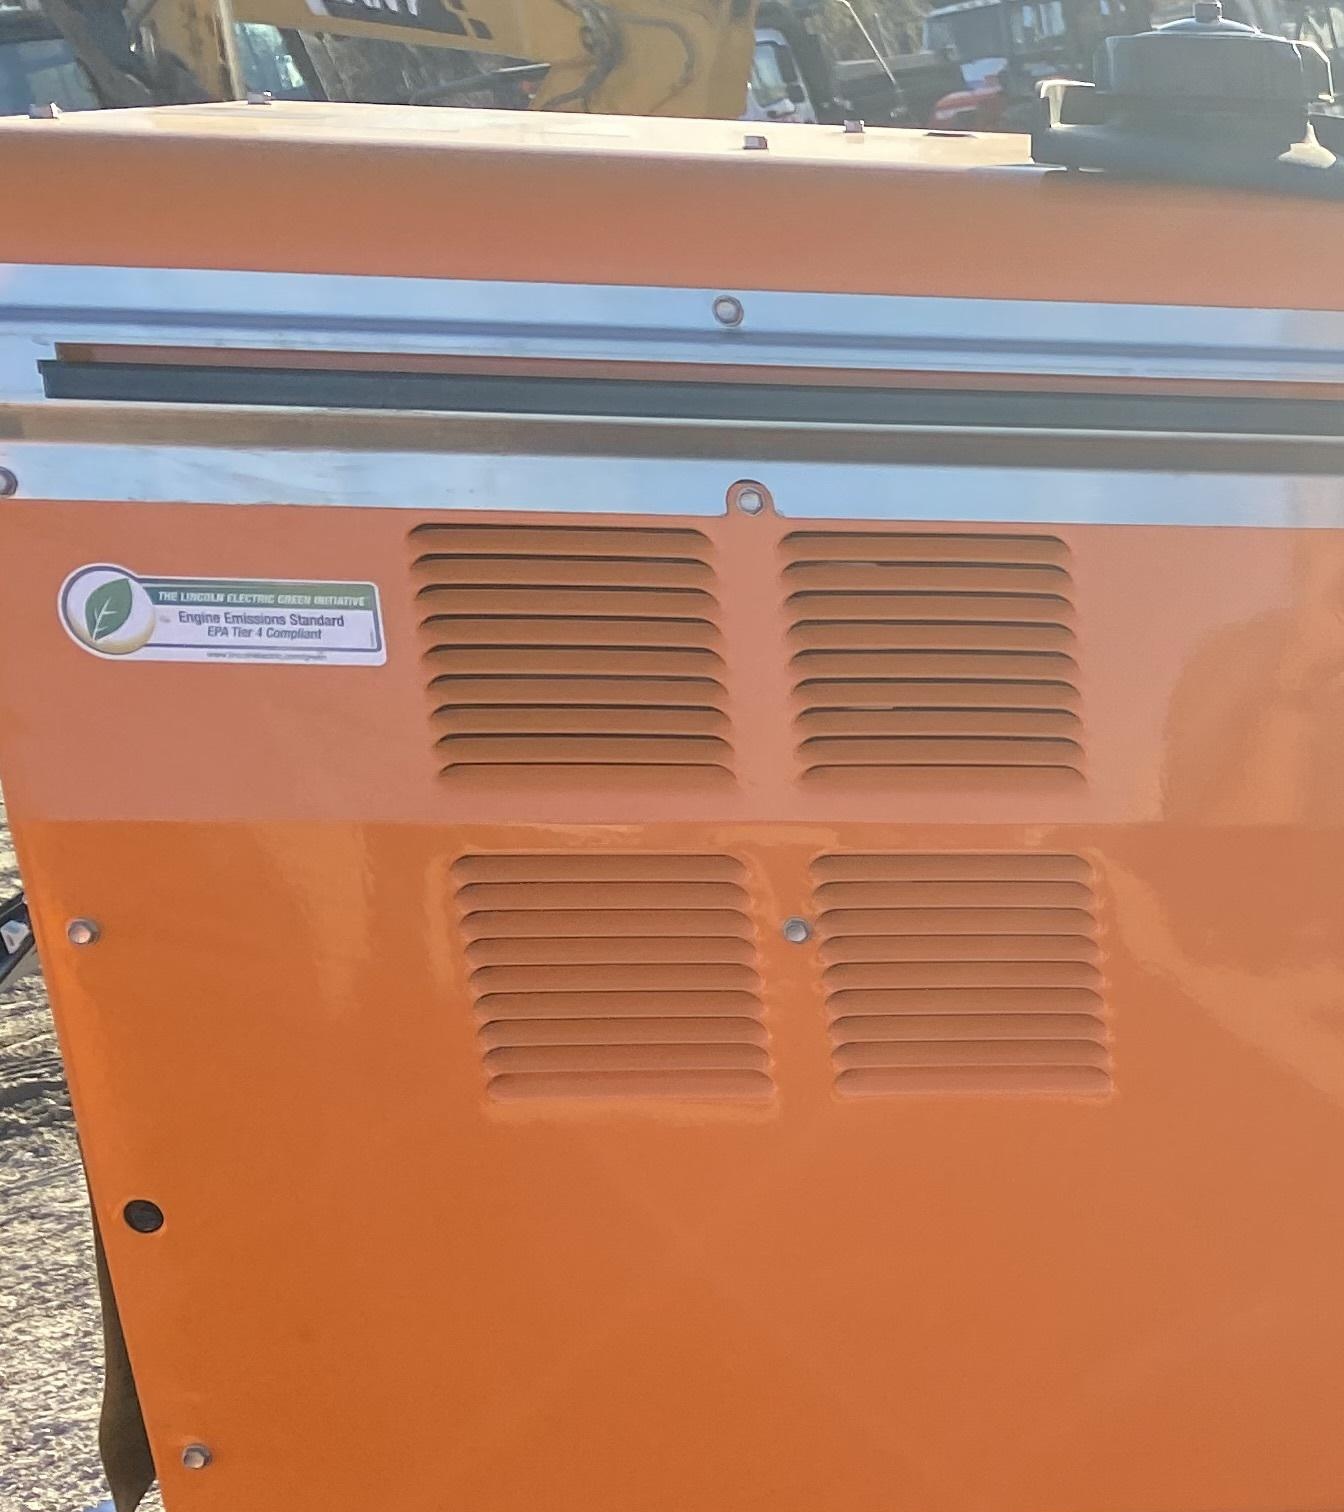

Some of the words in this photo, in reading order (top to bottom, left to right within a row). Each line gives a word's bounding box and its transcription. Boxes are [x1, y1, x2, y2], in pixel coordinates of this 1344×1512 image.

[158, 591, 177, 601] THE
[180, 592, 225, 602] LINCOLN
[227, 593, 275, 604] ELECTRIC
[278, 594, 312, 605] GREEN
[314, 596, 365, 607] INITIATIVE
[178, 610, 221, 626] Engine
[224, 612, 287, 626] Emissions
[289, 613, 345, 627] Standard
[207, 625, 229, 638] EPA
[231, 626, 253, 638] Tier
[255, 627, 263, 638] 4
[266, 627, 322, 641] Compliant
